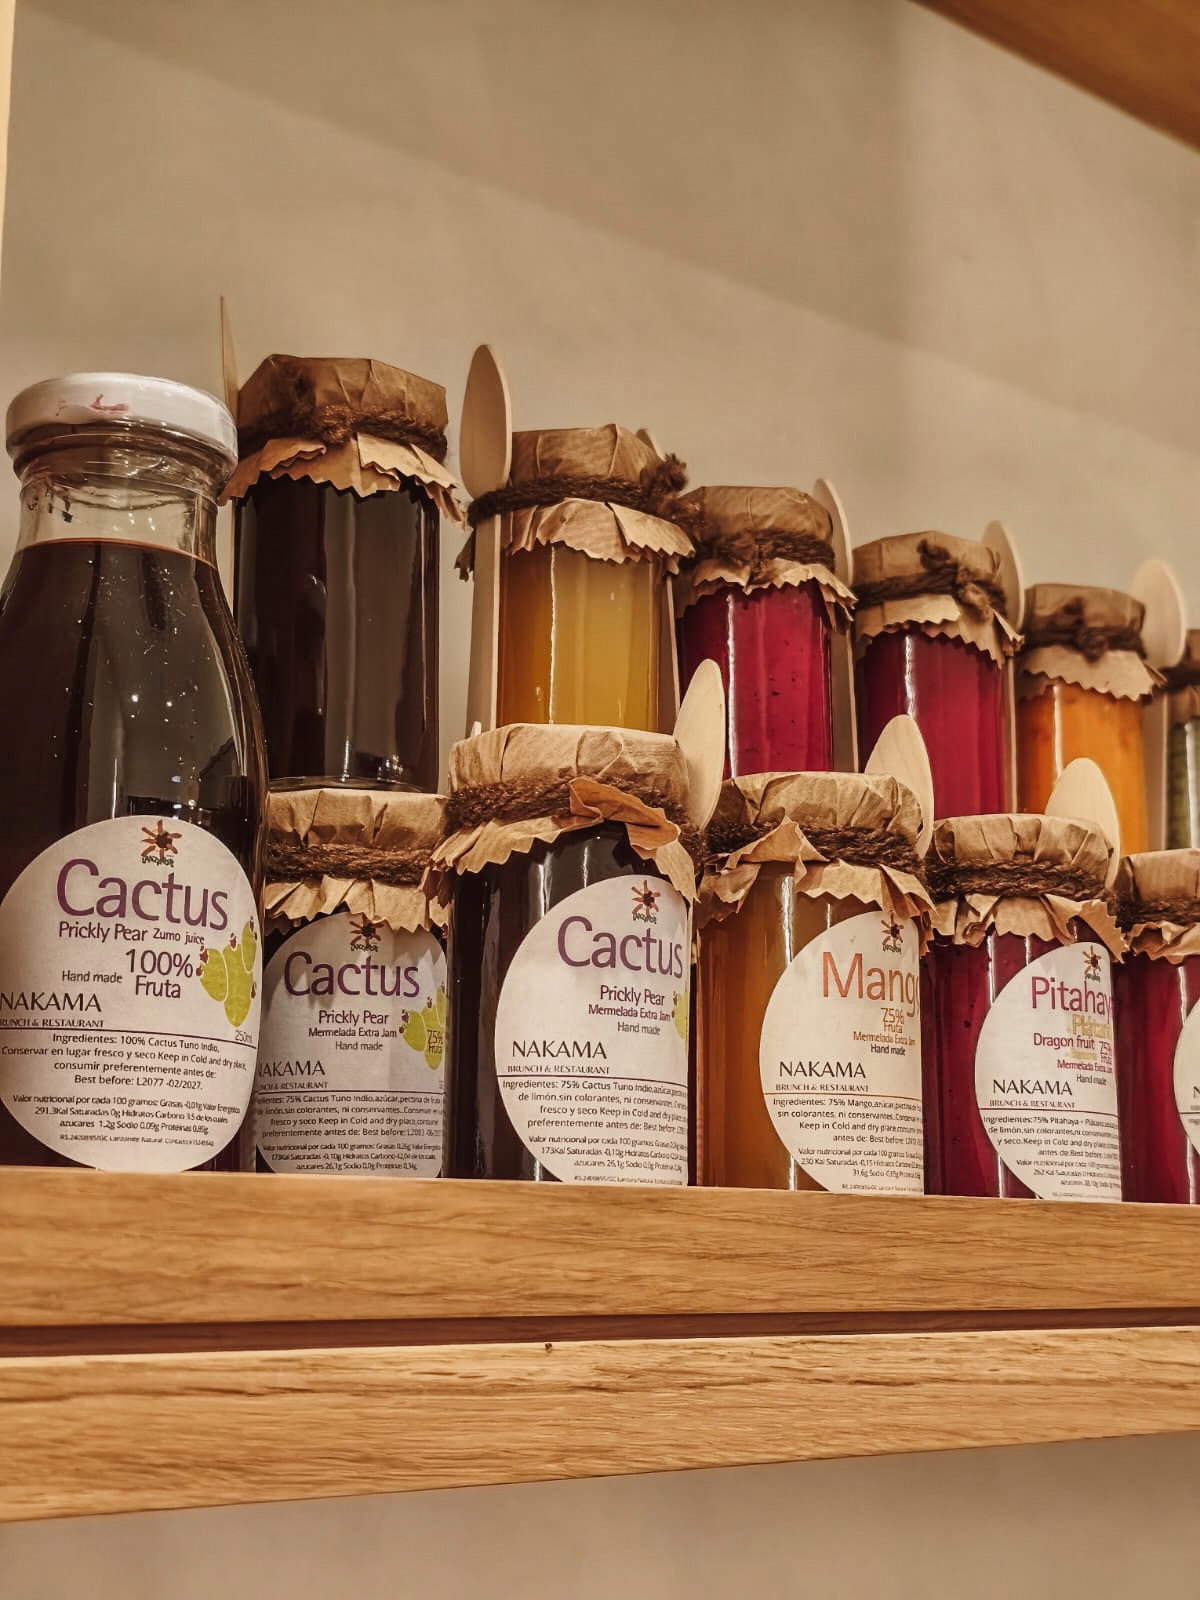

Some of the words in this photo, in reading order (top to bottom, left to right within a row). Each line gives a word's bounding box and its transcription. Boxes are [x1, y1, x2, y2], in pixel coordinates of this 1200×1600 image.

[57, 858, 228, 931] Cactus
[58, 921, 110, 943] Prickly
[114, 923, 148, 942] Pear
[152, 928, 181, 942] Zumo
[184, 931, 205, 945] juice
[557, 914, 683, 979] Cactus
[126, 949, 193, 978] 100%
[62, 970, 90, 983] Hand
[93, 971, 123, 984] made
[283, 951, 420, 998] Cactus
[135, 975, 181, 999] Fruta
[0, 991, 102, 1013] NAKAMA
[599, 985, 642, 1006] Prickly
[644, 988, 666, 1006] Pear
[1031, 975, 1113, 1025] Pitahay
[318, 1010, 359, 1027] Prickly
[363, 1010, 390, 1025] Pear
[588, 1003, 638, 1018] Mermelada
[639, 1007, 658, 1020] Extra
[658, 1010, 672, 1022] Jam
[880, 1007, 905, 1025] 75%
[42, 1019, 104, 1028] RESTAURANT
[617, 1021, 640, 1034] Hand
[641, 1024, 661, 1036] made
[883, 1023, 903, 1034] Fruta
[308, 1027, 356, 1037] Mermelada
[358, 1027, 380, 1037] Extra
[381, 1028, 397, 1038] Jam
[853, 1030, 894, 1043] Mermelada
[52, 1033, 118, 1045] Ingredientes:
[121, 1035, 146, 1046] 100%
[148, 1037, 178, 1048] Cactus
[179, 1040, 199, 1050] Tuno
[335, 1041, 359, 1051] Hand
[361, 1042, 384, 1051] made
[1033, 1032, 1074, 1050] Dragon
[1076, 1034, 1095, 1050] fruit
[512, 1039, 608, 1060] NAKAMA
[870, 1043, 890, 1054] Hand
[1, 1046, 48, 1055] Conservar
[51, 1048, 64, 1056] en
[66, 1047, 91, 1058] lugar
[94, 1048, 124, 1058] fresco
[126, 1051, 132, 1060] y
[135, 1052, 156, 1060] seco
[158, 1051, 180, 1063] Keep
[190, 1054, 207, 1064] Cold
[208, 1057, 221, 1065] and
[222, 1059, 232, 1069] dry
[54, 1061, 100, 1070] consumir
[103, 1063, 182, 1076] preferentemente
[183, 1068, 204, 1077] antes
[257, 1060, 326, 1077] AKAMA
[507, 1063, 543, 1074] BRUNCH
[544, 1064, 552, 1073] &
[553, 1064, 610, 1075] RESTAURANT
[779, 1060, 867, 1079] NAKAMA
[1057, 1059, 1095, 1072] Mermelada
[74, 1074, 96, 1084] Best
[99, 1075, 134, 1085] before:
[136, 1078, 164, 1086] L2077
[280, 1081, 328, 1090] RESTAURANT
[1076, 1074, 1094, 1084] Hand
[502, 1080, 559, 1090] Ingredientes:
[560, 1080, 580, 1089] 75%
[582, 1081, 611, 1090] Cactus
[613, 1081, 634, 1092] Tuno
[775, 1083, 810, 1092] BRUNCH
[820, 1084, 870, 1093] RESTAURANT
[992, 1079, 1073, 1096] NAKAMA
[12, 1094, 32, 1103] Valor
[33, 1095, 75, 1103] nutricional
[75, 1097, 89, 1106] por
[91, 1096, 111, 1105] cada
[112, 1096, 127, 1105] 100
[302, 1095, 329, 1103] Cactus
[331, 1094, 352, 1102] Tuno
[518, 1092, 530, 1101] de
[574, 1093, 622, 1105] colorantes,
[773, 1098, 827, 1108] Ingredientes:
[828, 1098, 846, 1107] 75%
[989, 1099, 1022, 1107] BRUNCH
[1030, 1100, 1075, 1109] RESTAURANT
[296, 1106, 340, 1115] colorantes,
[540, 1105, 568, 1114] fresco
[569, 1108, 576, 1117] y
[599, 1107, 621, 1118] Keep
[632, 1108, 649, 1118] Cold
[649, 1110, 661, 1119] and
[777, 1110, 789, 1118] sin
[116, 1121, 139, 1129] Sodio
[318, 1117, 339, 1126] Keep
[350, 1116, 368, 1125] Cold
[369, 1117, 384, 1125] and
[385, 1116, 398, 1127] dry
[527, 1118, 604, 1129] preferentemente
[605, 1121, 629, 1130] antes
[643, 1122, 658, 1132] Best
[799, 1121, 821, 1131] Keep
[822, 1121, 830, 1130] in
[831, 1122, 850, 1131] Cold
[851, 1123, 866, 1132] and
[867, 1123, 879, 1133] dry
[1050, 1116, 1080, 1127] Pitahaya
[262, 1129, 322, 1138] preferentemente
[362, 1128, 379, 1136] Best
[832, 1134, 855, 1143] antes
[869, 1134, 885, 1144] Best
[528, 1136, 547, 1144] Valor
